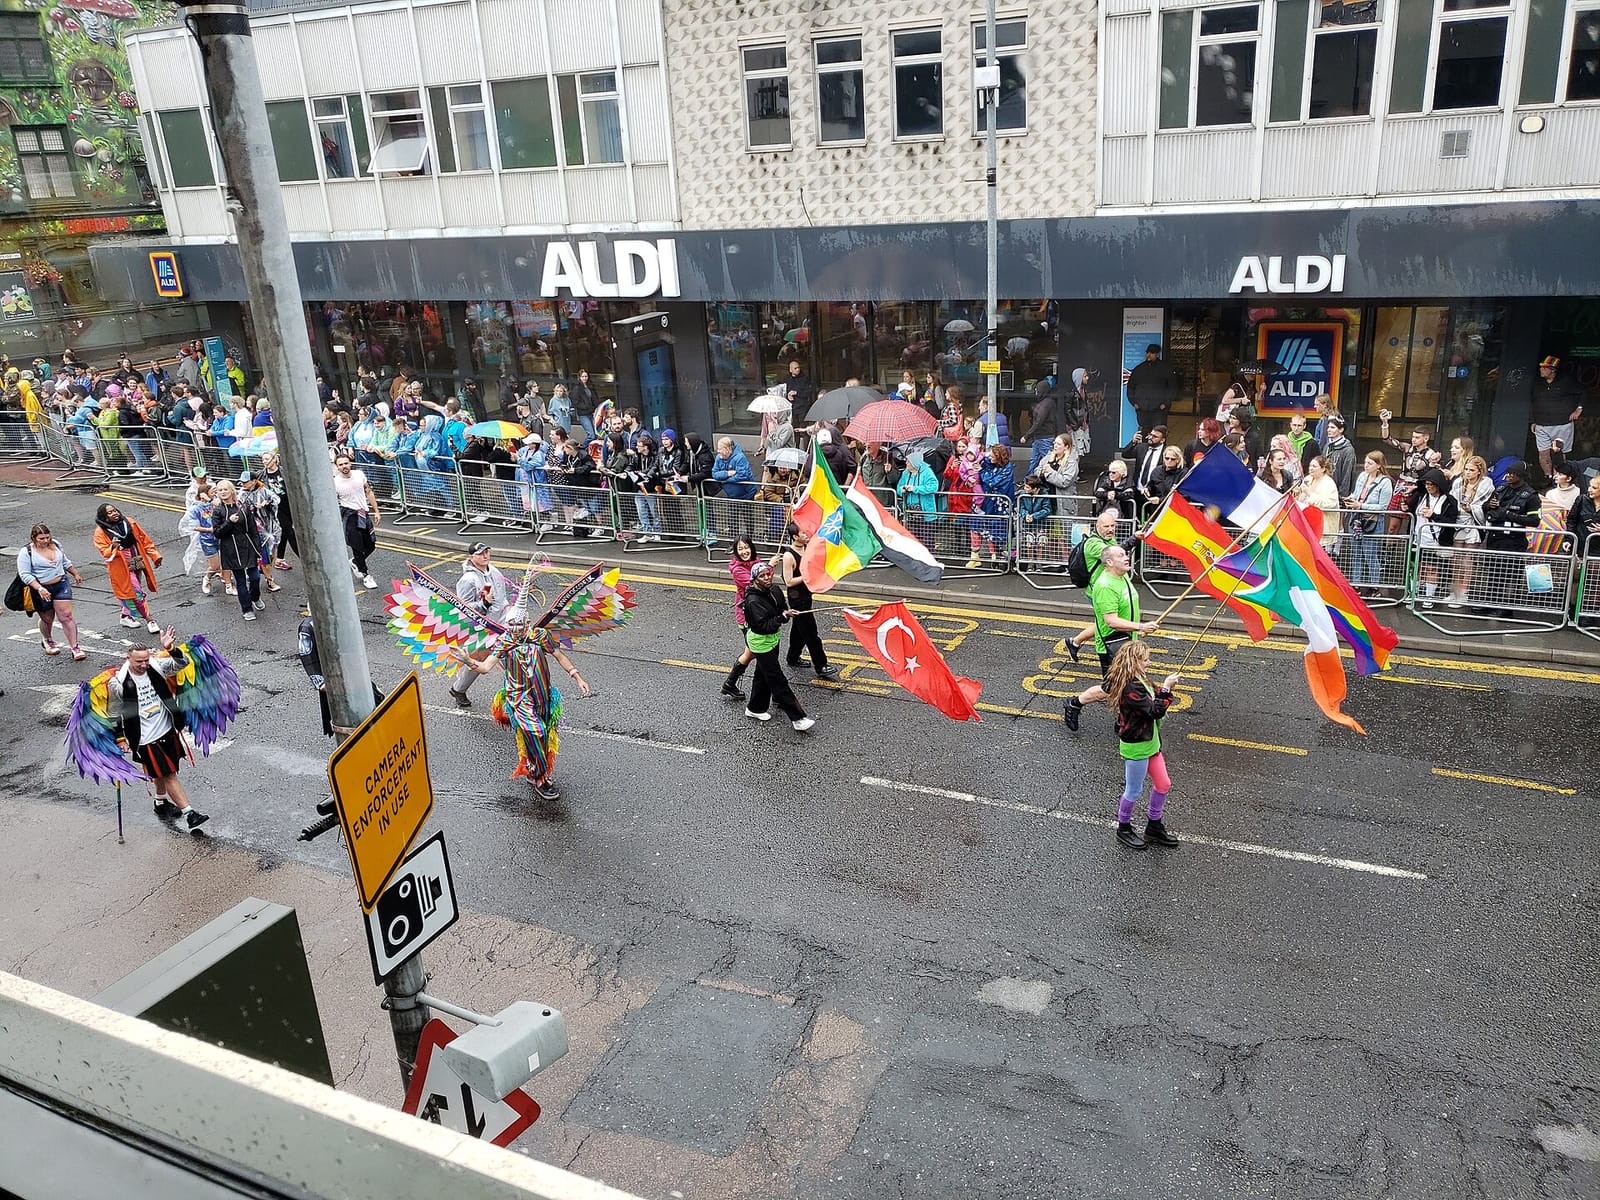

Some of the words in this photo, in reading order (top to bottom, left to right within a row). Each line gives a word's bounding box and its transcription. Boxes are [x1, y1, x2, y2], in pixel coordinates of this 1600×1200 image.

[161, 278, 177, 286] ALDI
[540, 238, 681, 298] ALDI
[1228, 254, 1347, 293] ALDI
[1269, 380, 1326, 397] ALDI
[417, 576, 439, 593] HAPPY
[437, 588, 464, 610] BRIGHTON
[462, 604, 479, 621] PRIDE
[353, 738, 421, 840] ENFORCEMENT
[365, 736, 406, 794] CAMERA
[378, 810, 391, 835] IN
[391, 782, 410, 816] USE
